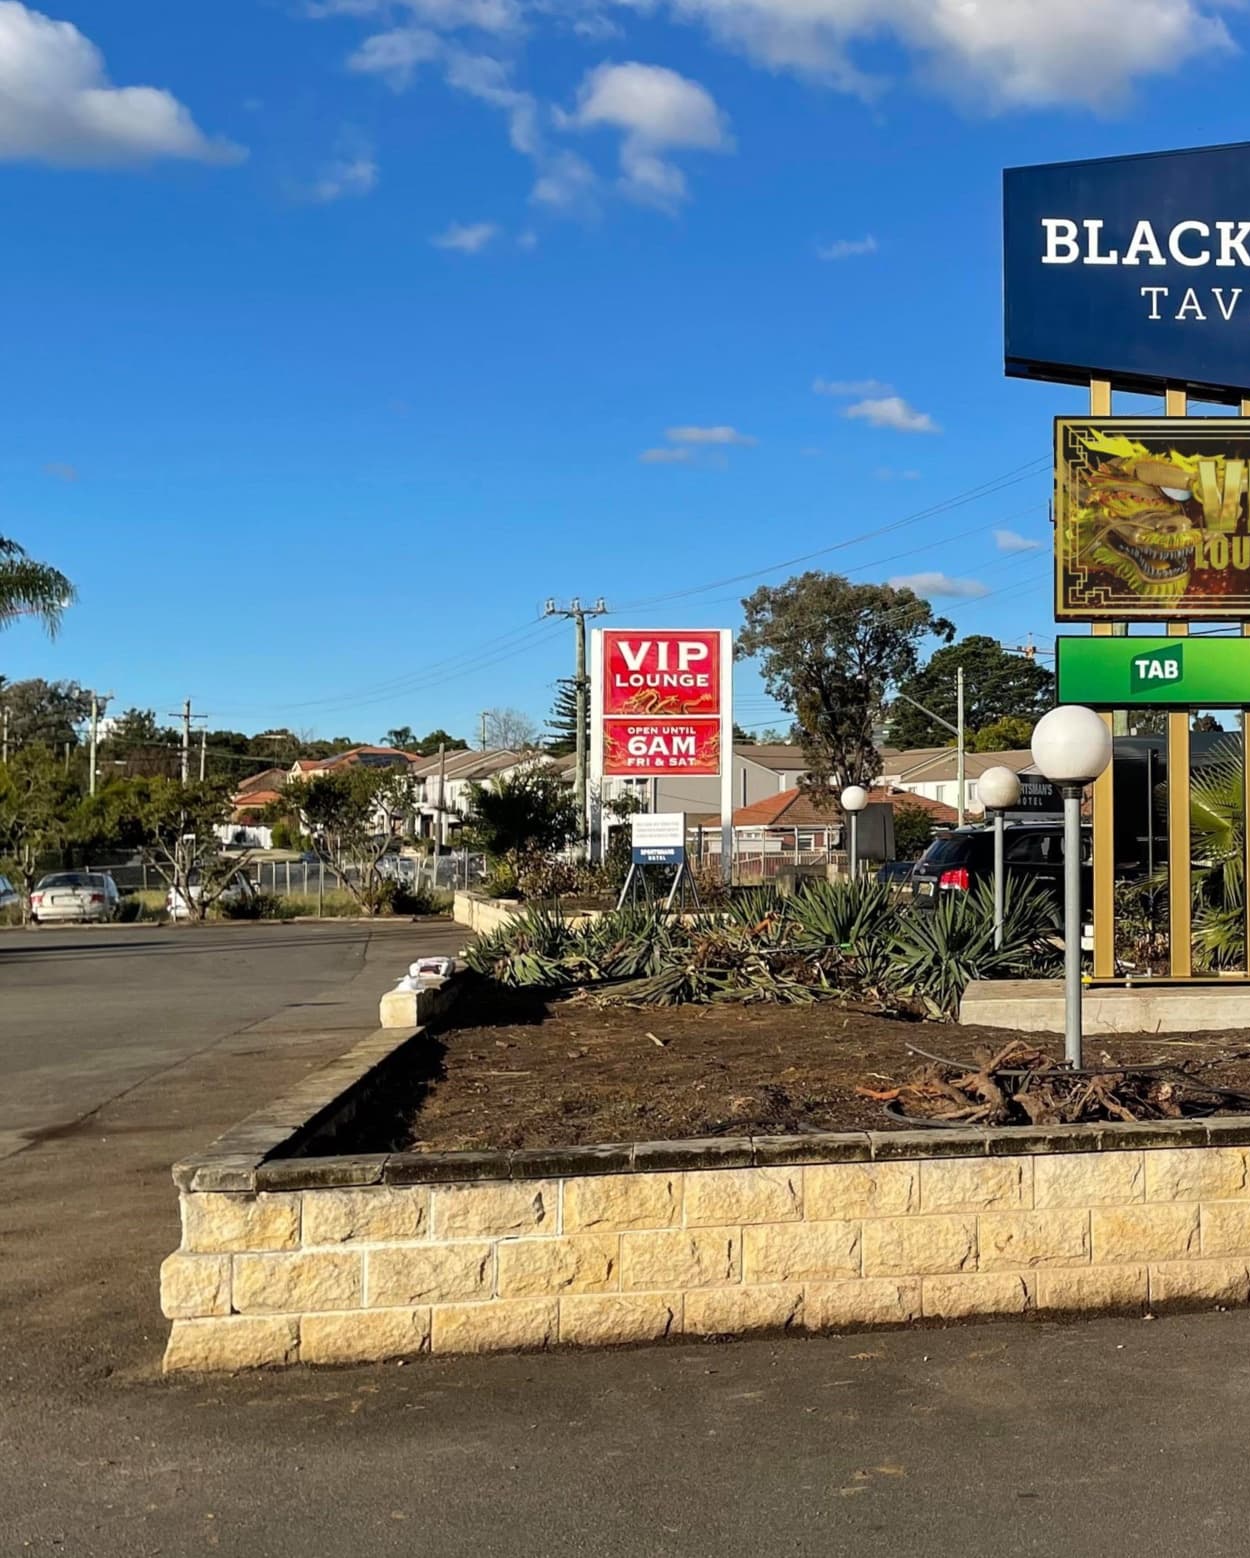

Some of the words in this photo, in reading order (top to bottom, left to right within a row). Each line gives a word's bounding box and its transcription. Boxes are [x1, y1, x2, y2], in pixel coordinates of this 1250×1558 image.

[617, 641, 709, 671] VIP
[1135, 659, 1179, 680] TAB
[616, 673, 709, 687] LOUNGE
[627, 727, 659, 735] OPEN
[662, 727, 696, 735] UNTIL
[627, 736, 696, 756] 6AM
[627, 757, 650, 767] FRI
[655, 757, 664, 767] &
